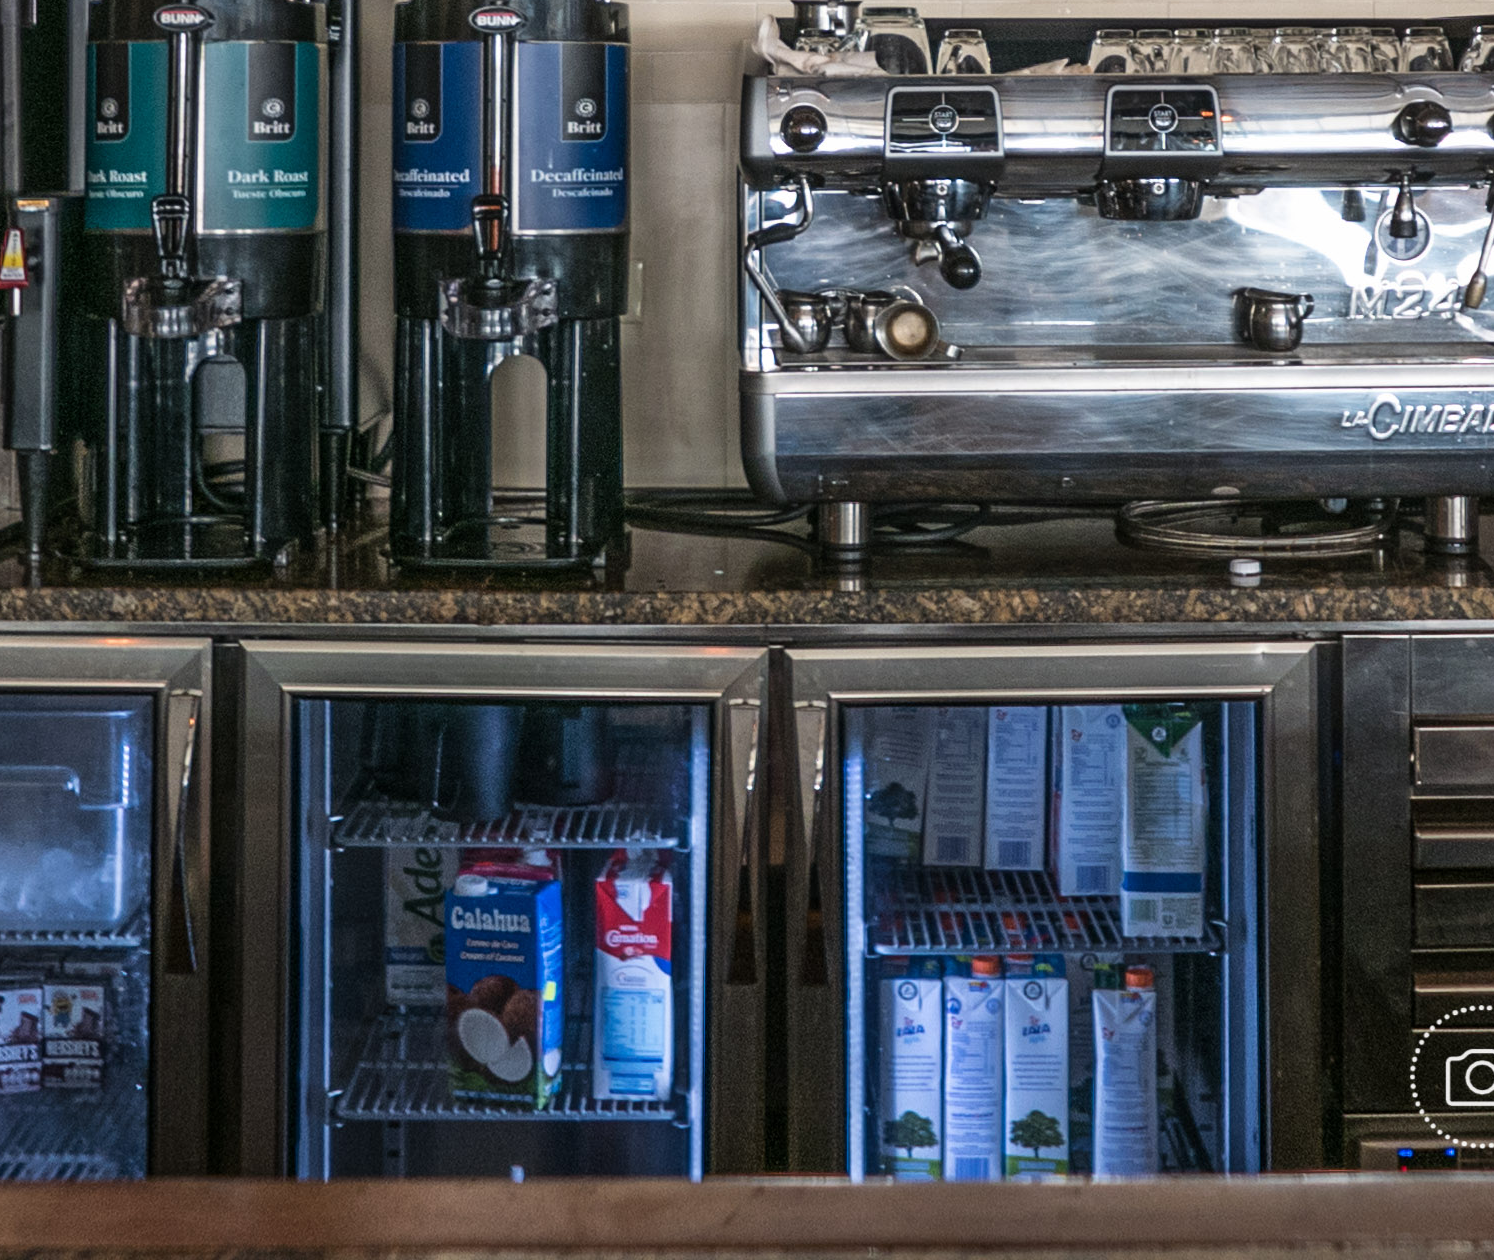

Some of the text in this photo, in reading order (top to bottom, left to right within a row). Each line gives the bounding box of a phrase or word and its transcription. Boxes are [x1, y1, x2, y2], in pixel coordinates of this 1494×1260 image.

[160, 13, 200, 24] BUNN
[477, 14, 516, 26] BUNN
[97, 121, 124, 134] Britt
[254, 121, 290, 134] Britt
[407, 121, 435, 134] Britt
[567, 121, 601, 134] Britt
[109, 170, 148, 183] Roast
[227, 169, 308, 183] Dark Roast
[531, 168, 624, 183] Decaffeinated
[1341, 411, 1369, 428] LA
[450, 906, 531, 933] Calahua
